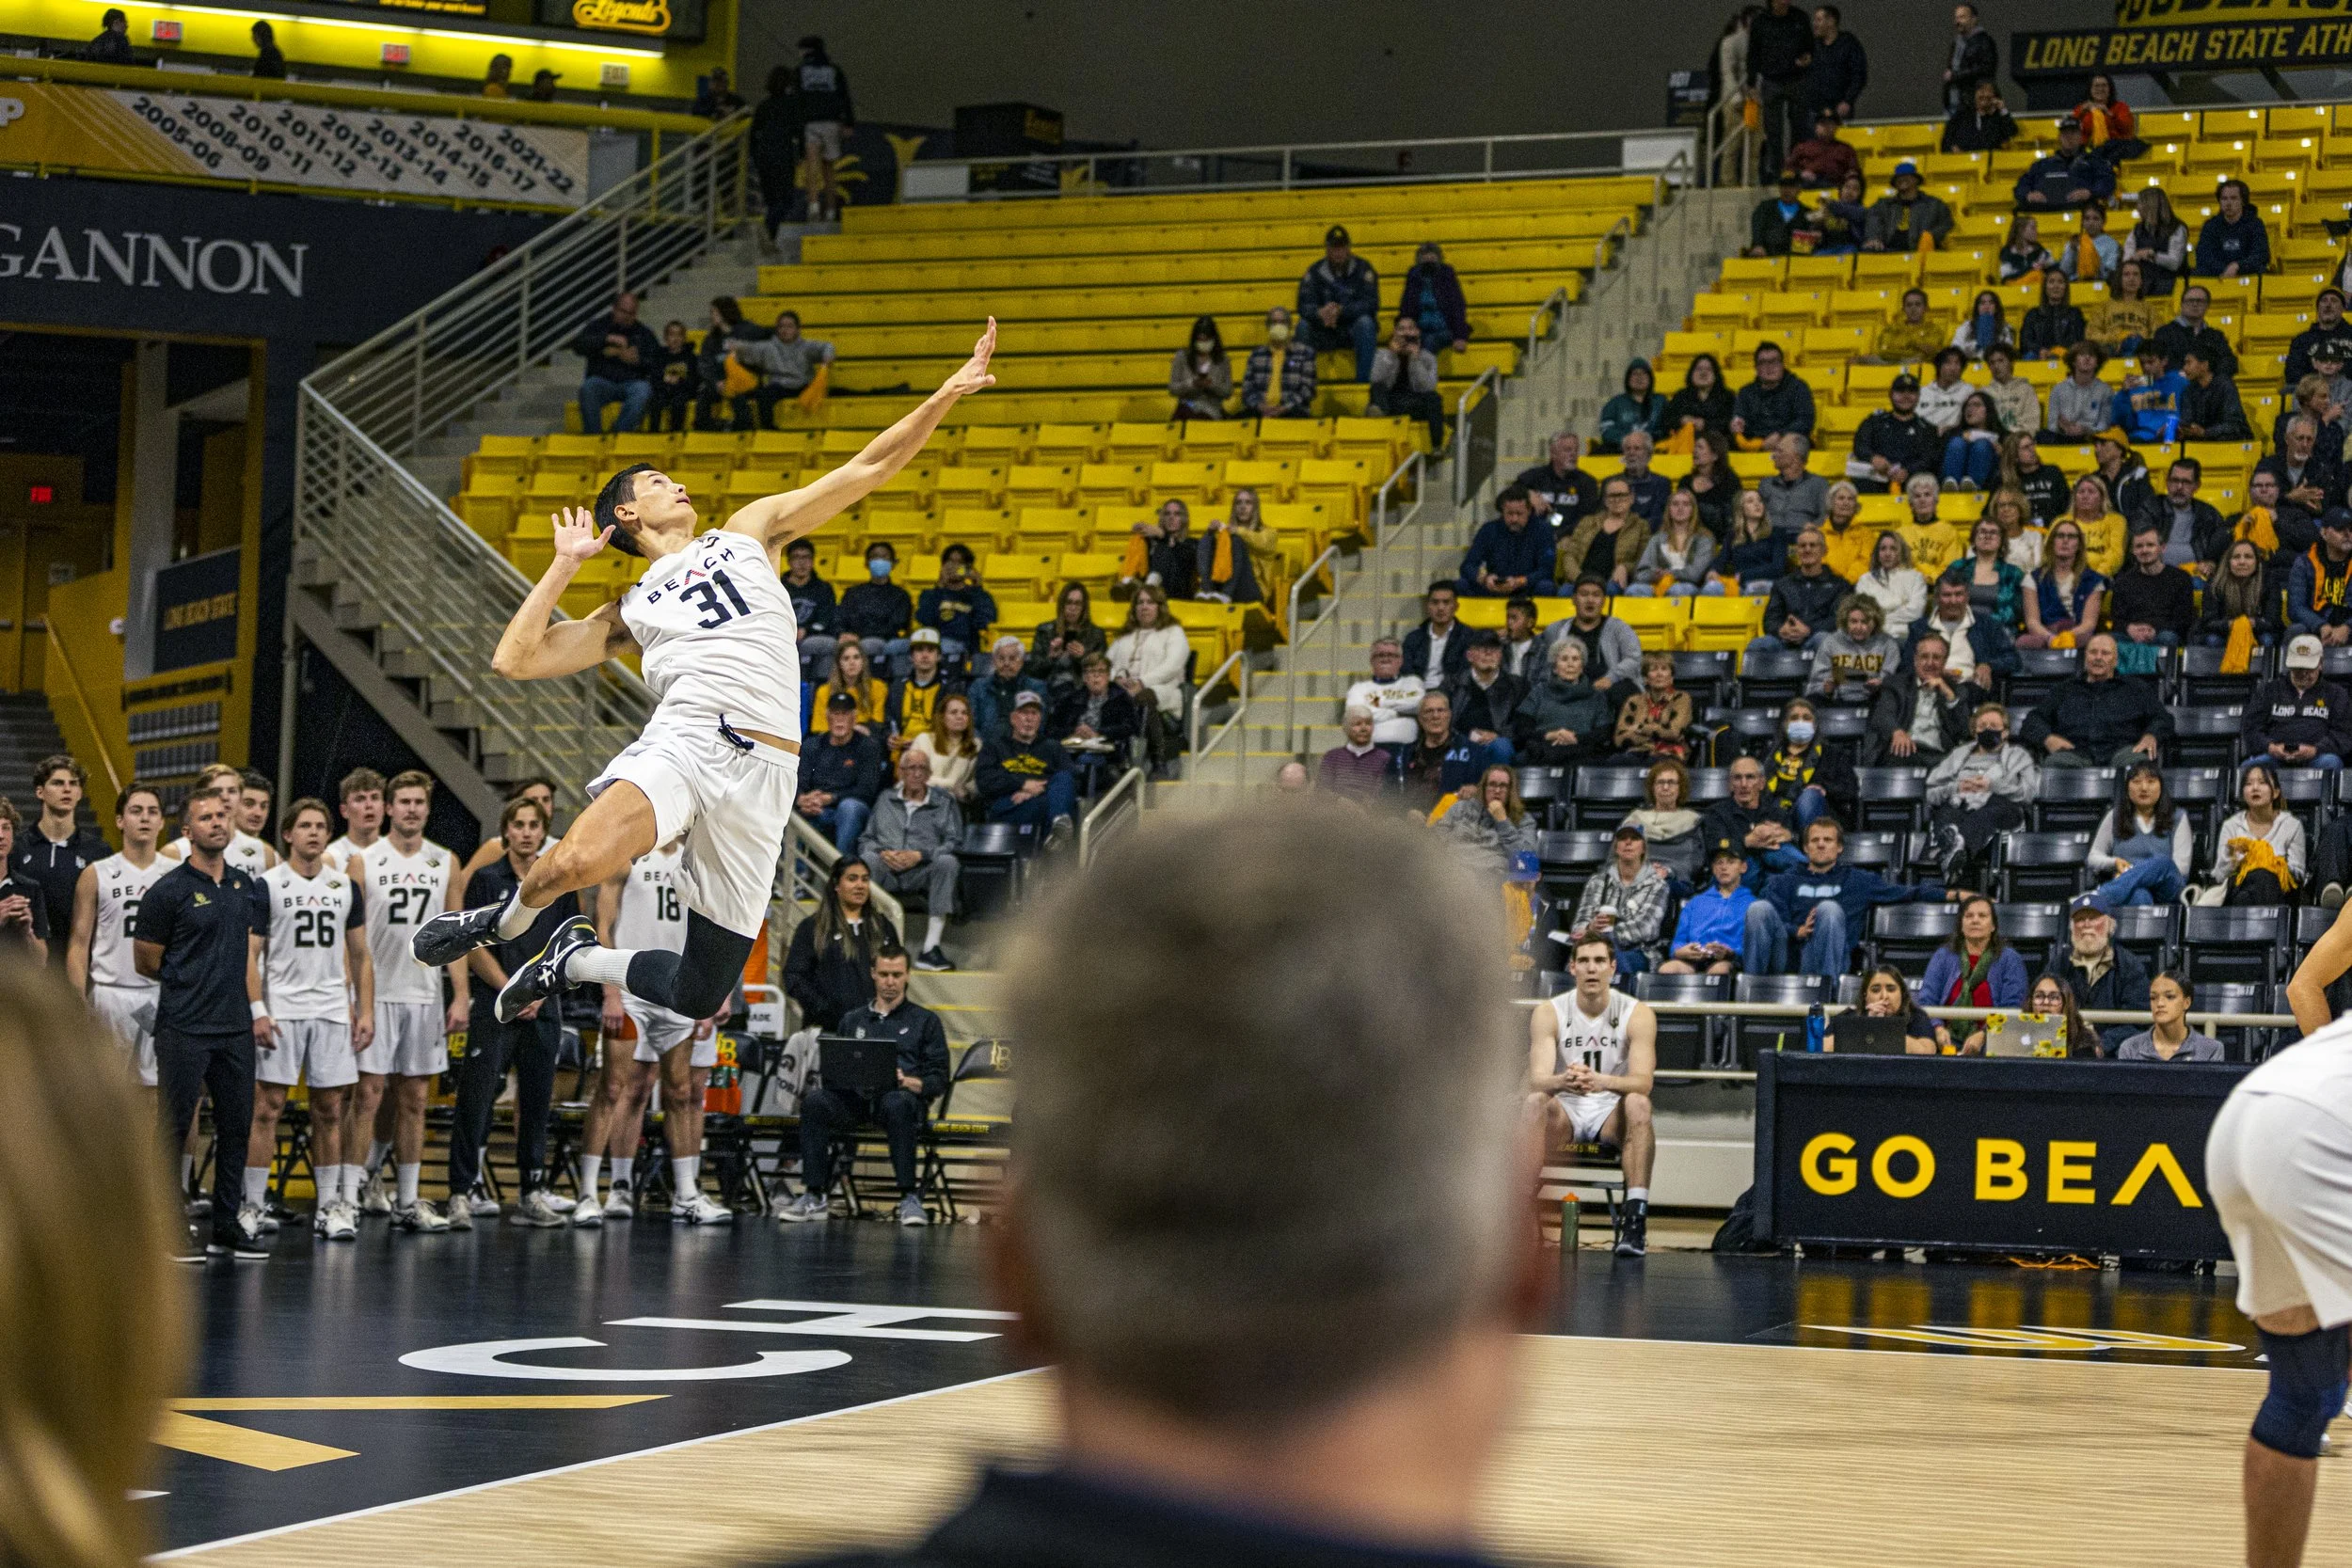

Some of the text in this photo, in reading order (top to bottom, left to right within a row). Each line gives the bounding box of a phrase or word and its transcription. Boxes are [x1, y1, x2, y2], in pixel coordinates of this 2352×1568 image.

[2025, 36, 2100, 69] LONG
[2105, 29, 2200, 65] BEACH
[2204, 25, 2294, 61] STATE
[133, 96, 223, 169] 2005-06
[182, 101, 271, 172] 2008-09
[229, 104, 313, 175] 2010-11
[277, 109, 357, 178] 2011-12
[321, 113, 403, 182] 2012-13
[366, 118, 448, 185] 2013-14
[407, 120, 491, 188] 2014-15
[454, 123, 536, 192] 2016-17
[497, 127, 574, 195] 2021-22
[647, 548, 736, 605] BEACH
[679, 569, 751, 629] 31
[284, 895, 342, 909] BEACH
[379, 873, 439, 887] BEACH
[389, 888, 432, 925] 27
[656, 885, 681, 923] 18
[294, 910, 336, 948] 26
[1565, 1036, 1618, 1049] BEACH
[1582, 1050, 1603, 1073] 11
[1800, 1132, 2204, 1208] GO BEA
